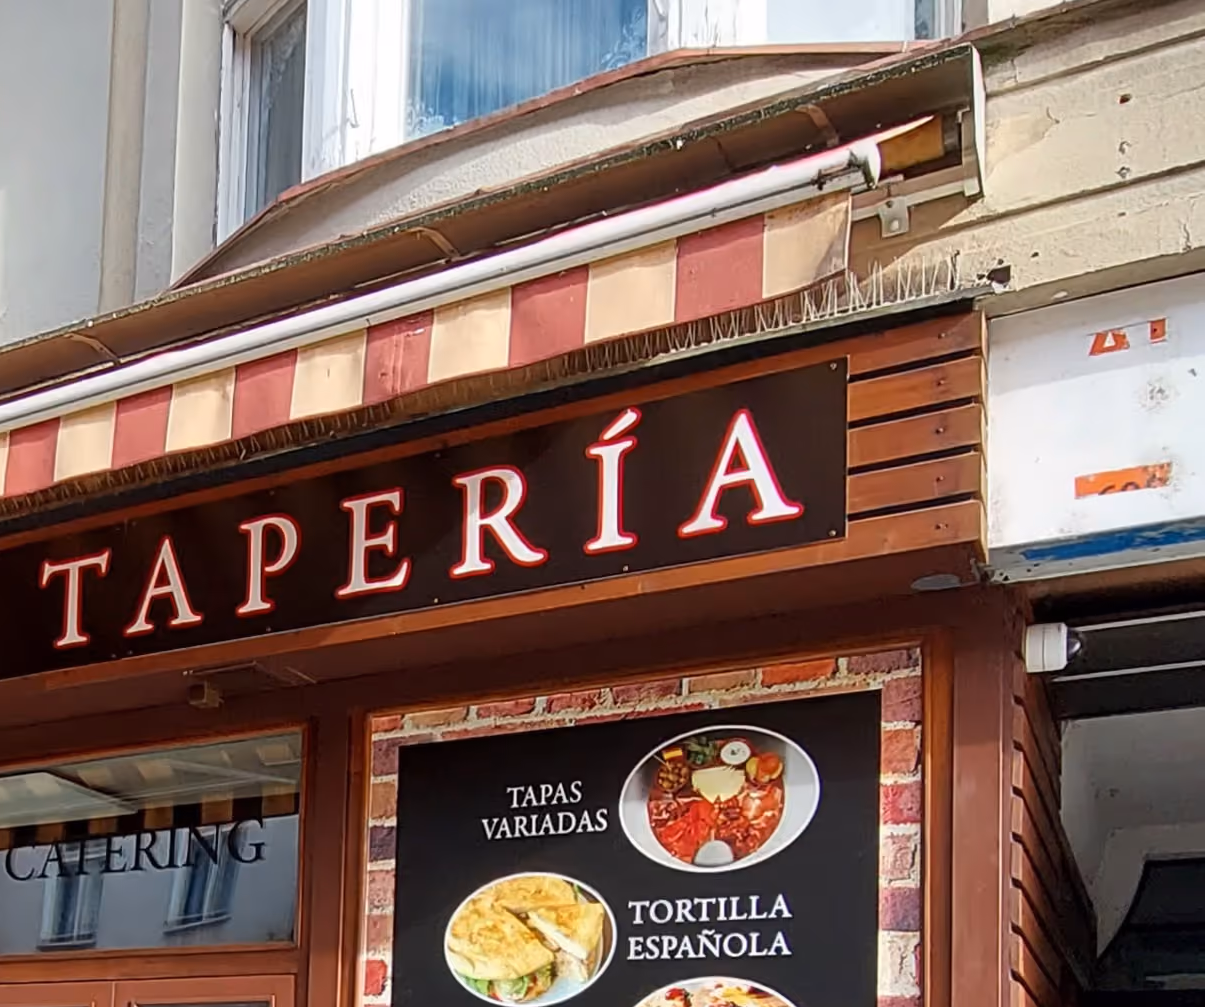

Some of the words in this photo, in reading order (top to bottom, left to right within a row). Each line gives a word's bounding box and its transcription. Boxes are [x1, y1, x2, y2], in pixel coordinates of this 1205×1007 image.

[39, 407, 804, 650] TAPERÍA
[507, 781, 583, 809] TAPAS
[481, 809, 609, 840] VARIADAS
[4, 817, 266, 881] CATERING
[628, 894, 792, 925] TORTILLA
[627, 930, 792, 961] ESPAÑOLA
